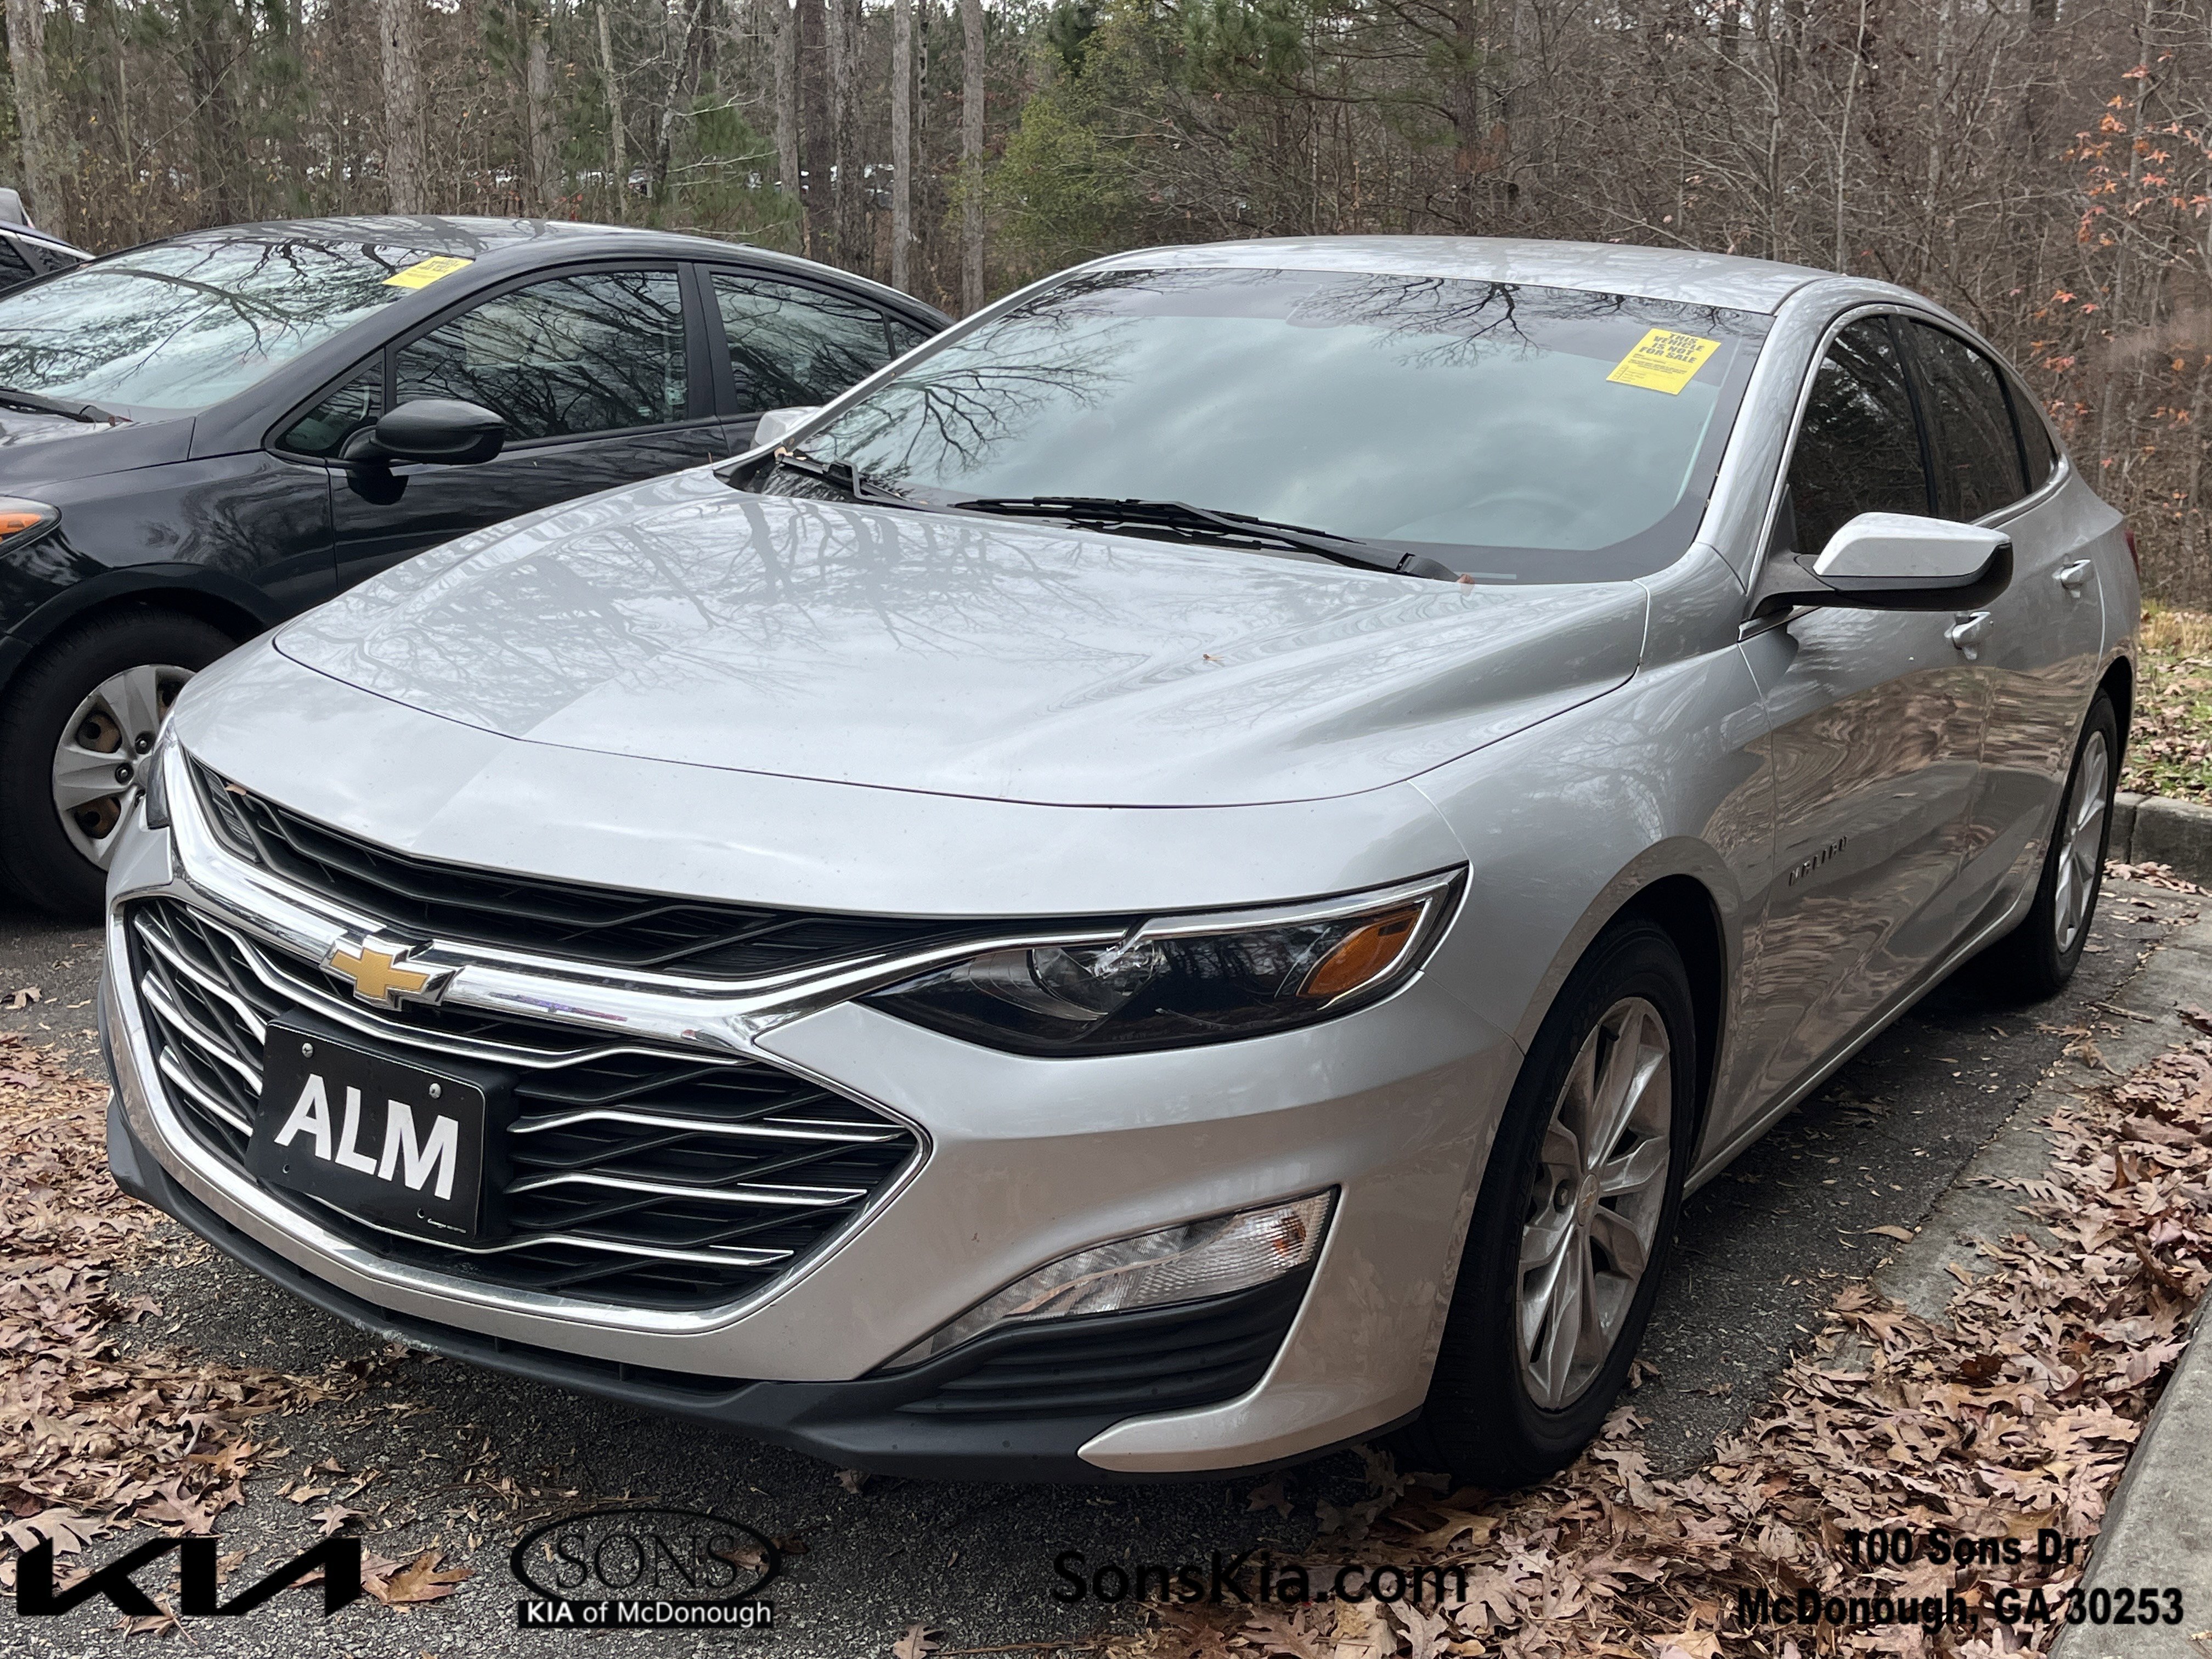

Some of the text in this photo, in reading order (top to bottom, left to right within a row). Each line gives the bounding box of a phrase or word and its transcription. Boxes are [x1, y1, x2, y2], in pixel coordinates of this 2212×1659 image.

[1653, 336, 1705, 352] VEHICLE
[1669, 332, 1699, 344] THIS
[1639, 346, 1664, 357] FOR
[1666, 352, 1697, 364] SALE
[1667, 346, 1695, 356] NOT
[274, 1073, 459, 1200] ALM
